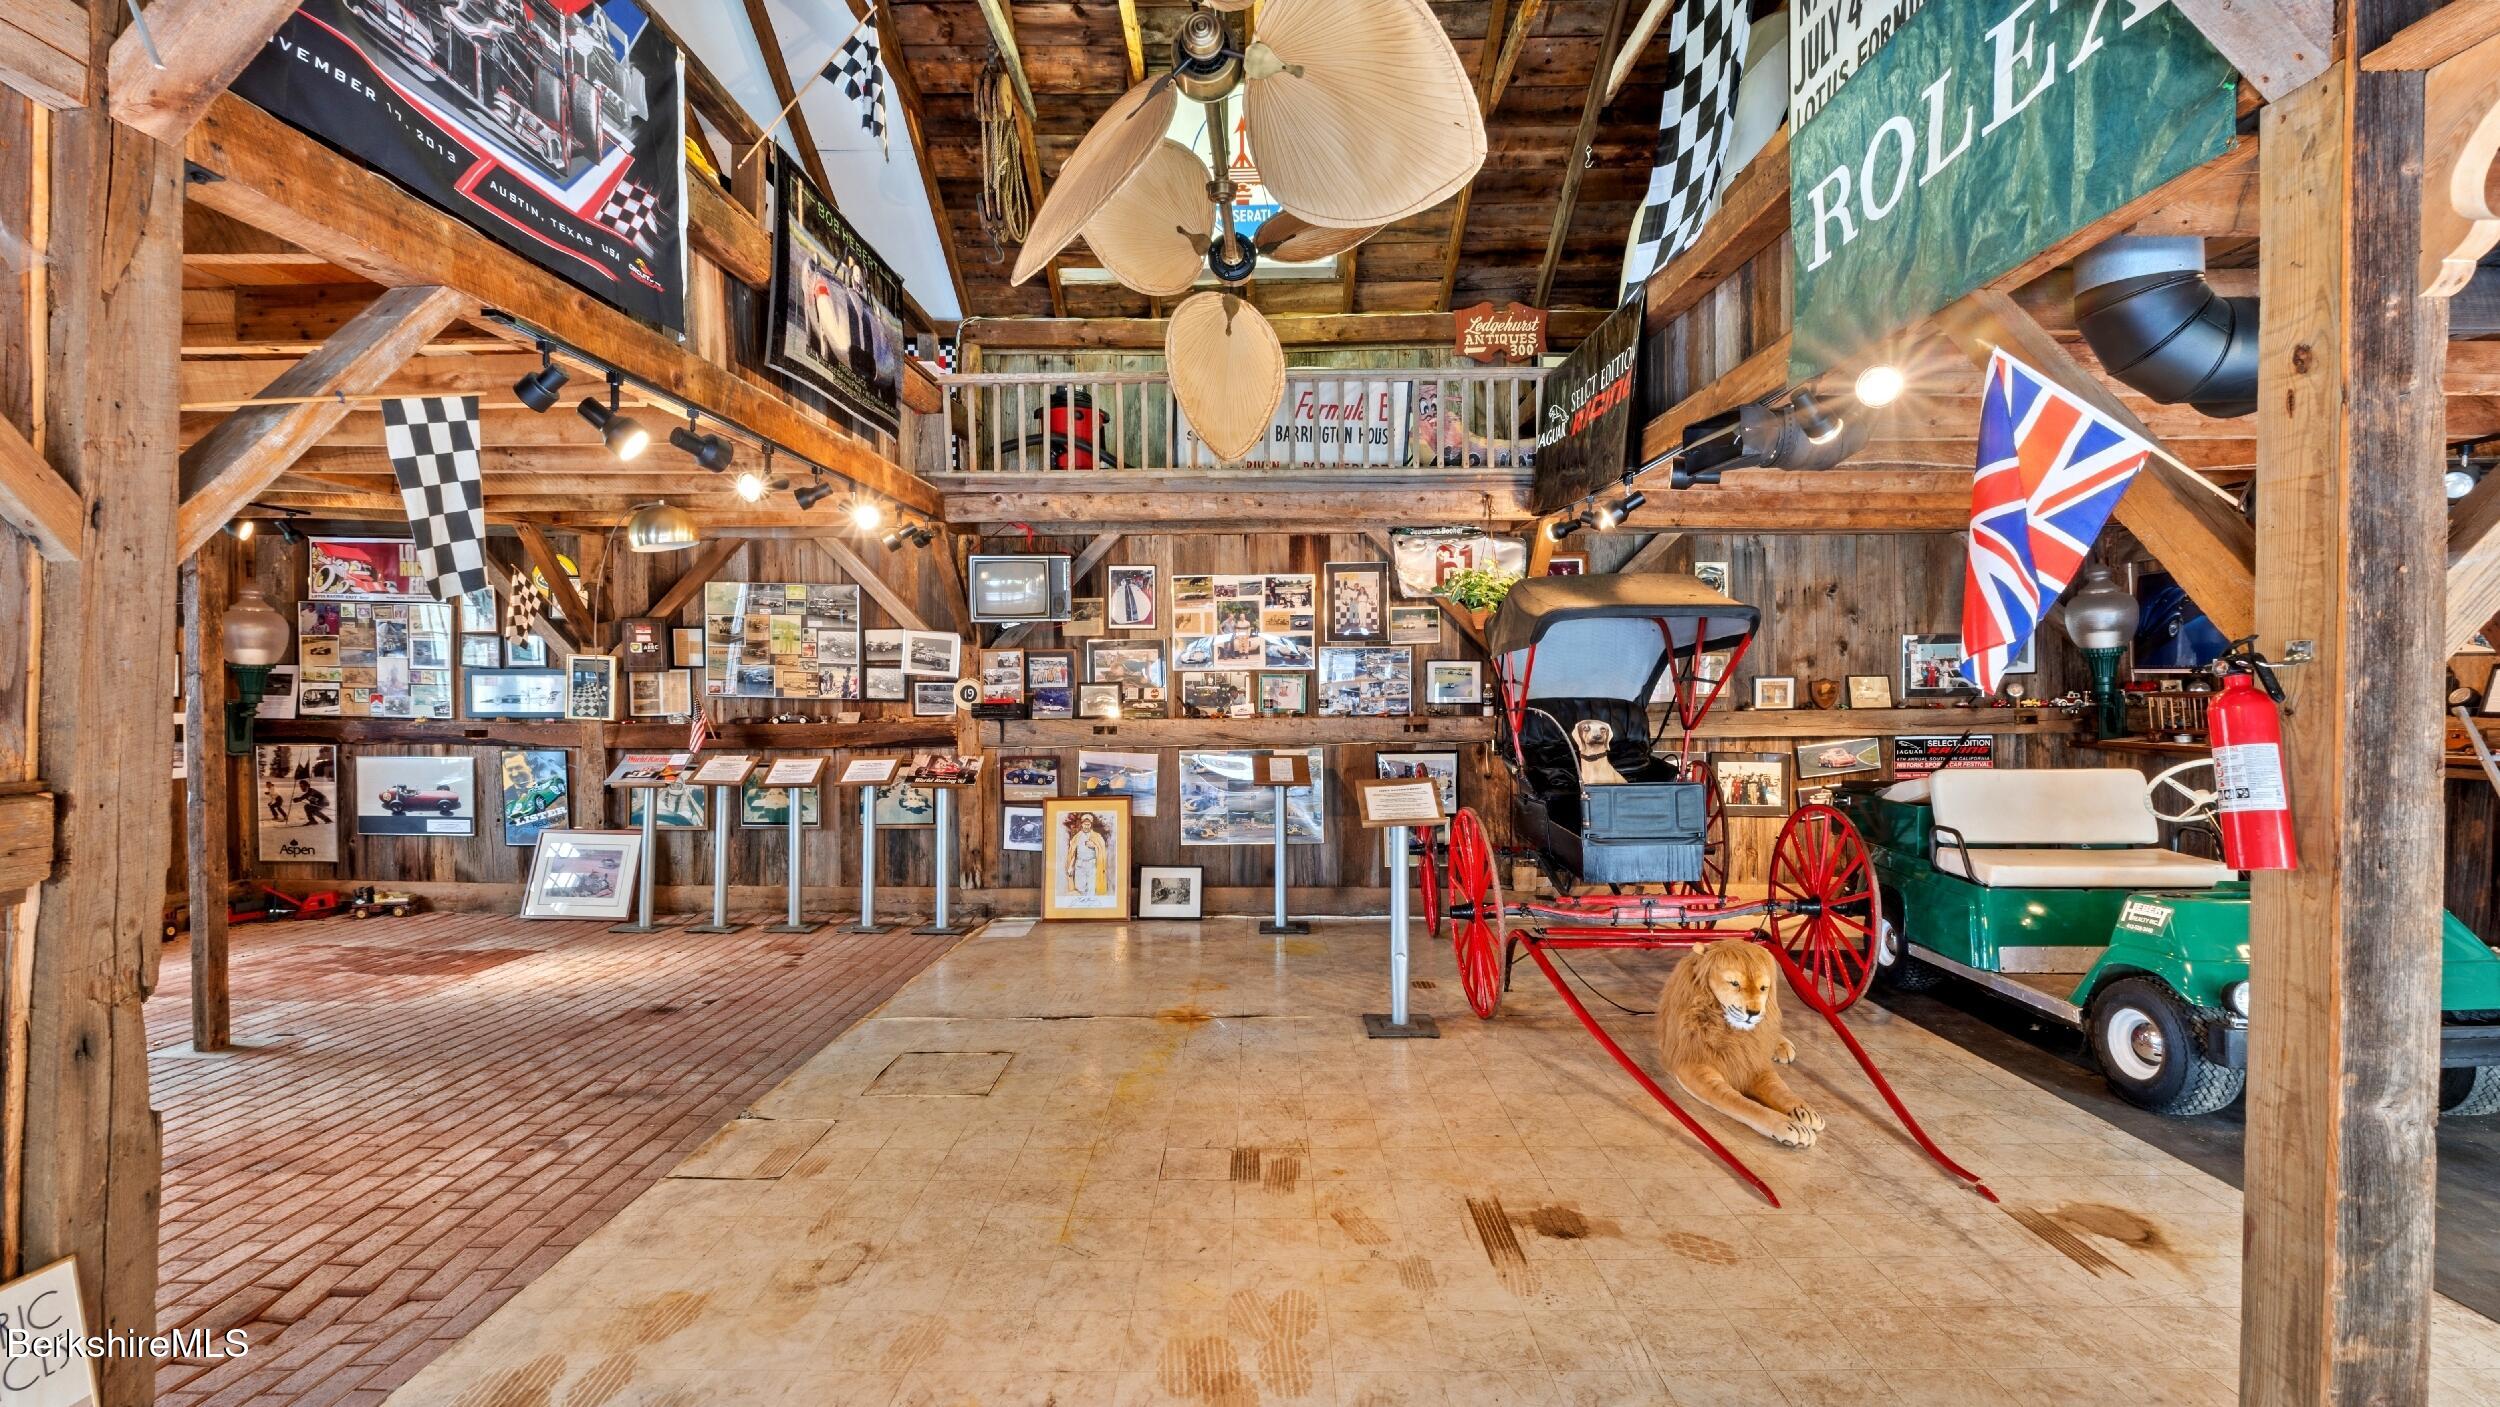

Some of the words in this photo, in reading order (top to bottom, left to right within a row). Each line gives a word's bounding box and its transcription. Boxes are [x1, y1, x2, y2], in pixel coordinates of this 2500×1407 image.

[1857, 0, 1927, 68] FORM
[1794, 0, 1842, 95] JULY
[268, 36, 376, 102] VEMBER
[386, 102, 409, 130] 17,
[416, 128, 456, 163] 2013
[489, 180, 545, 222] AUSTIN,
[550, 217, 594, 246] TEXAS
[601, 243, 620, 262] USA
[1216, 209, 1272, 223] MSERATI
[817, 201, 840, 234] BOB
[842, 227, 879, 271] HEBERT
[1464, 315, 1540, 333] Ledgehurst
[1465, 333, 1538, 345] ANTIQUES
[1570, 372, 1598, 412] SELCT
[1600, 346, 1636, 390] EDITION
[1275, 425, 1353, 444] BARRIGTON
[1359, 426, 1396, 445] HOUS
[1927, 739, 1957, 747] SELECT
[1959, 739, 1991, 747] DITION
[515, 806, 568, 826] LISTER
[280, 845, 326, 858] Aspen
[2121, 900, 2174, 927] HEBERT
